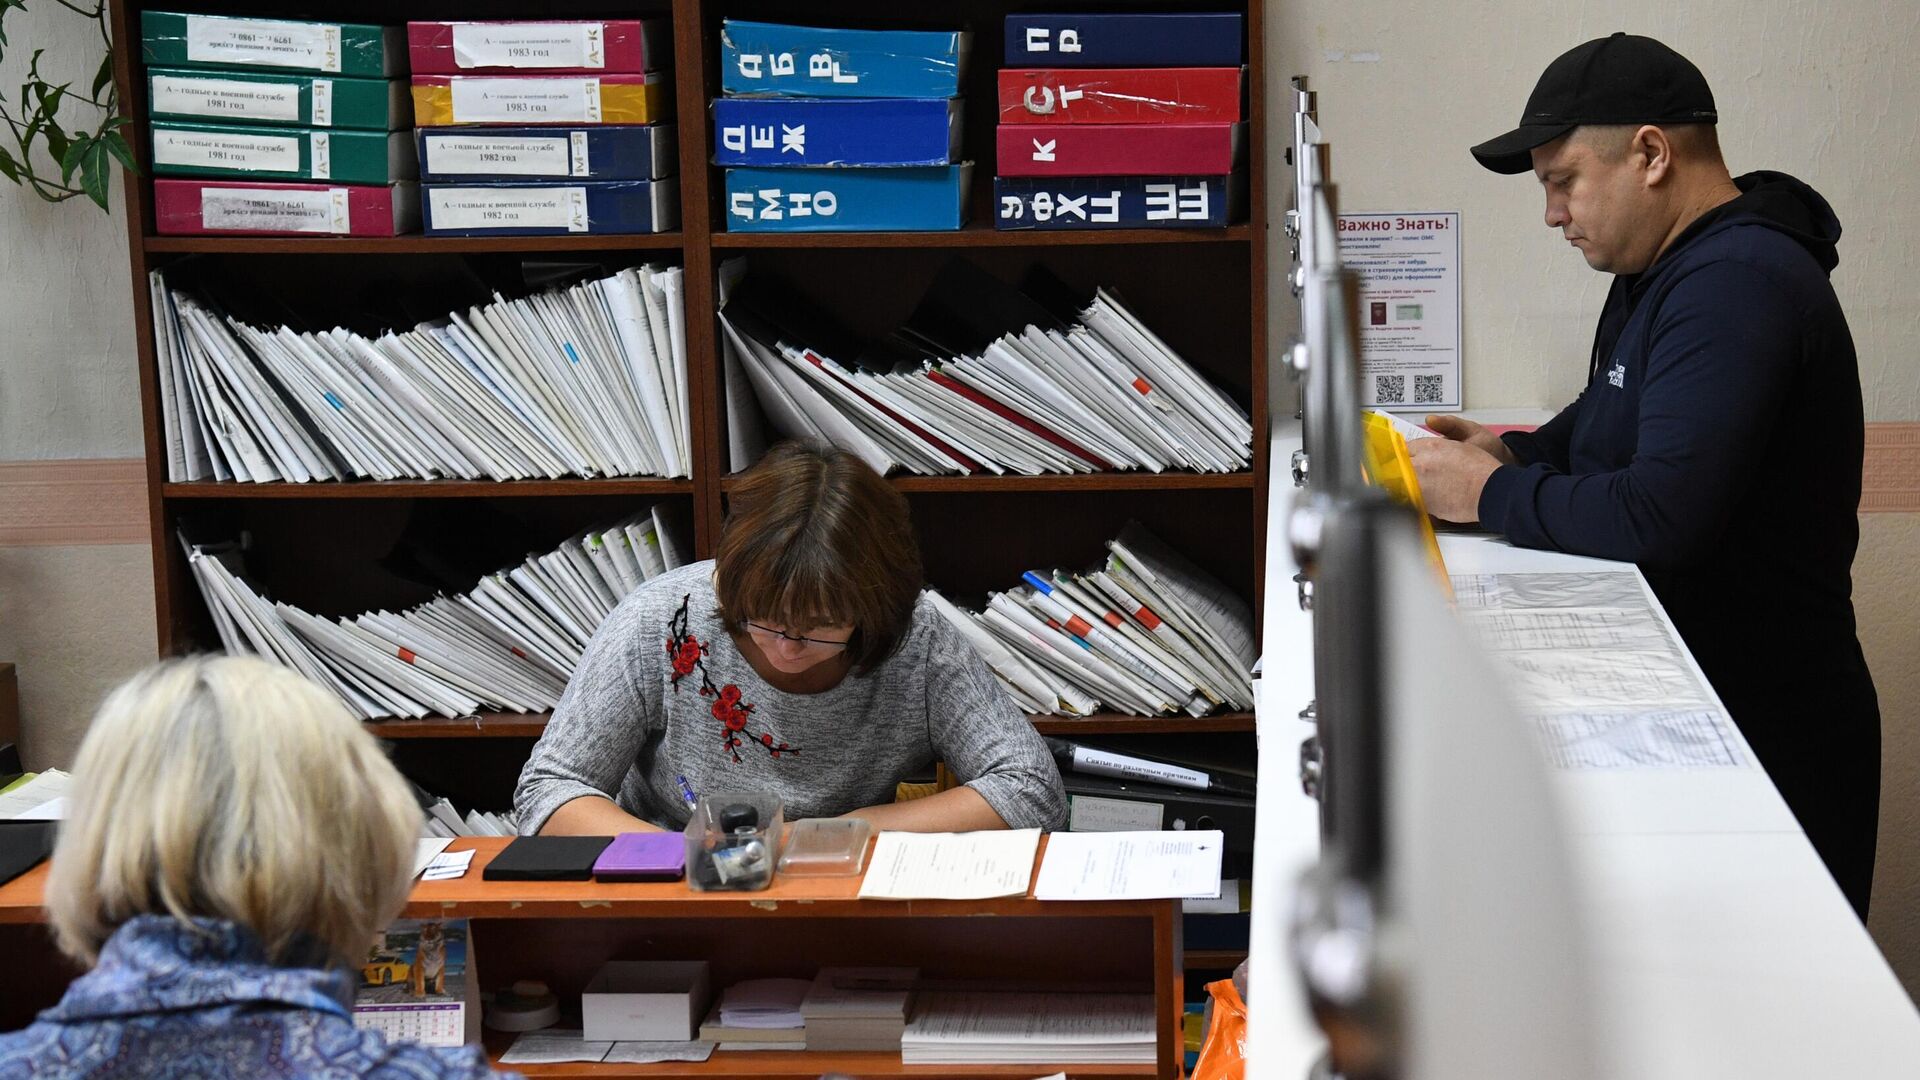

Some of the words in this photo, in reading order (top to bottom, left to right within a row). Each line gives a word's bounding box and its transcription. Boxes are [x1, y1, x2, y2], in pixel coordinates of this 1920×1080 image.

[209, 41, 234, 49] службе
[508, 48, 530, 57] 1983
[533, 50, 549, 58] год
[181, 88, 211, 96] годные
[220, 91, 254, 99] военной
[256, 93, 285, 102] службе
[207, 99, 227, 108] 1981
[229, 102, 245, 110] год
[506, 103, 527, 112] 1983
[167, 137, 174, 145] А
[183, 140, 212, 148] годные
[222, 142, 255, 150] военной
[256, 145, 285, 153] службе
[208, 150, 227, 160] 1981
[230, 153, 246, 161] год
[480, 153, 499, 161] 1982
[529, 202, 556, 210] службе
[1338, 219, 1391, 231] Важно
[1396, 217, 1448, 231] Знать!
